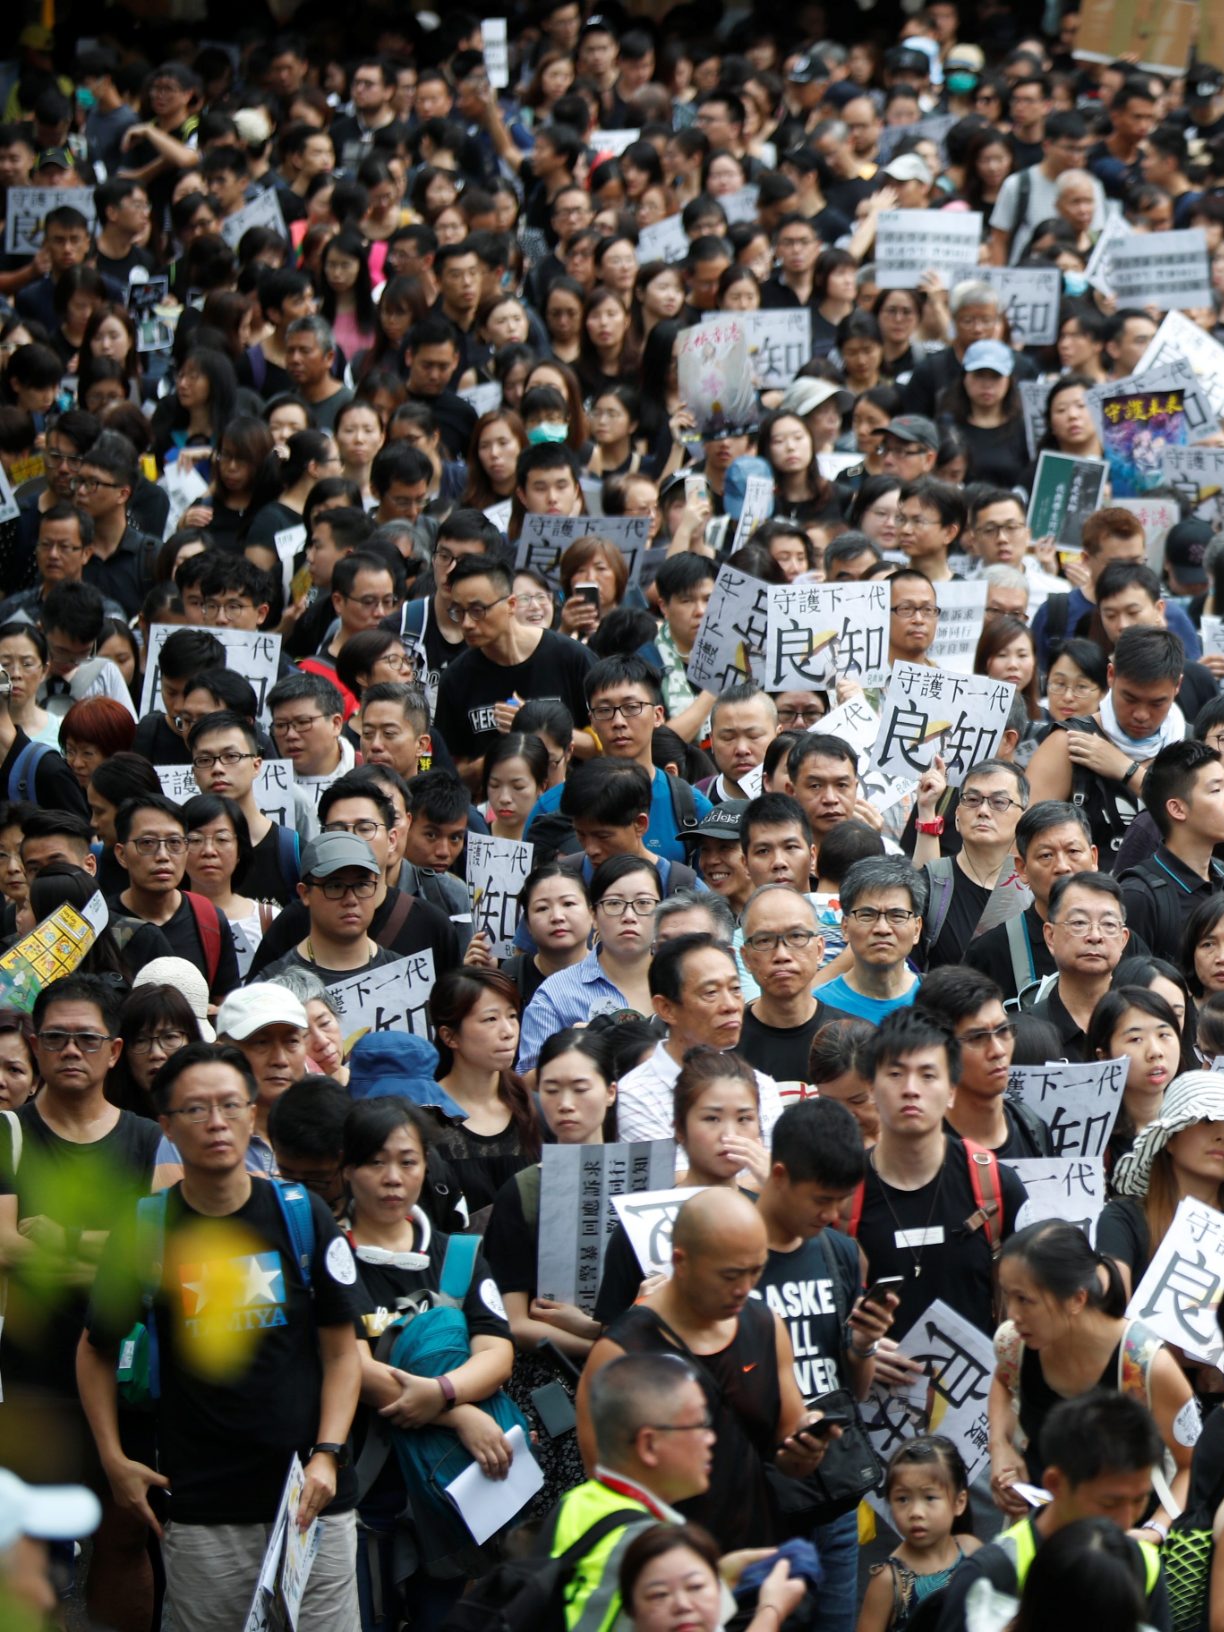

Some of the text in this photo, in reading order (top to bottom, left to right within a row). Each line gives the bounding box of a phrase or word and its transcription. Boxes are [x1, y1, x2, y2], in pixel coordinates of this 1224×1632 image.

[528, 519, 646, 540] 守護下一代
[773, 584, 887, 616] 守護下一代
[773, 616, 885, 687] 良知
[897, 665, 1010, 714] 守護下一代
[471, 706, 499, 732] HER
[877, 698, 999, 777] 良知
[1138, 1249, 1222, 1345] 良
[184, 1306, 289, 1340] TMIYA
